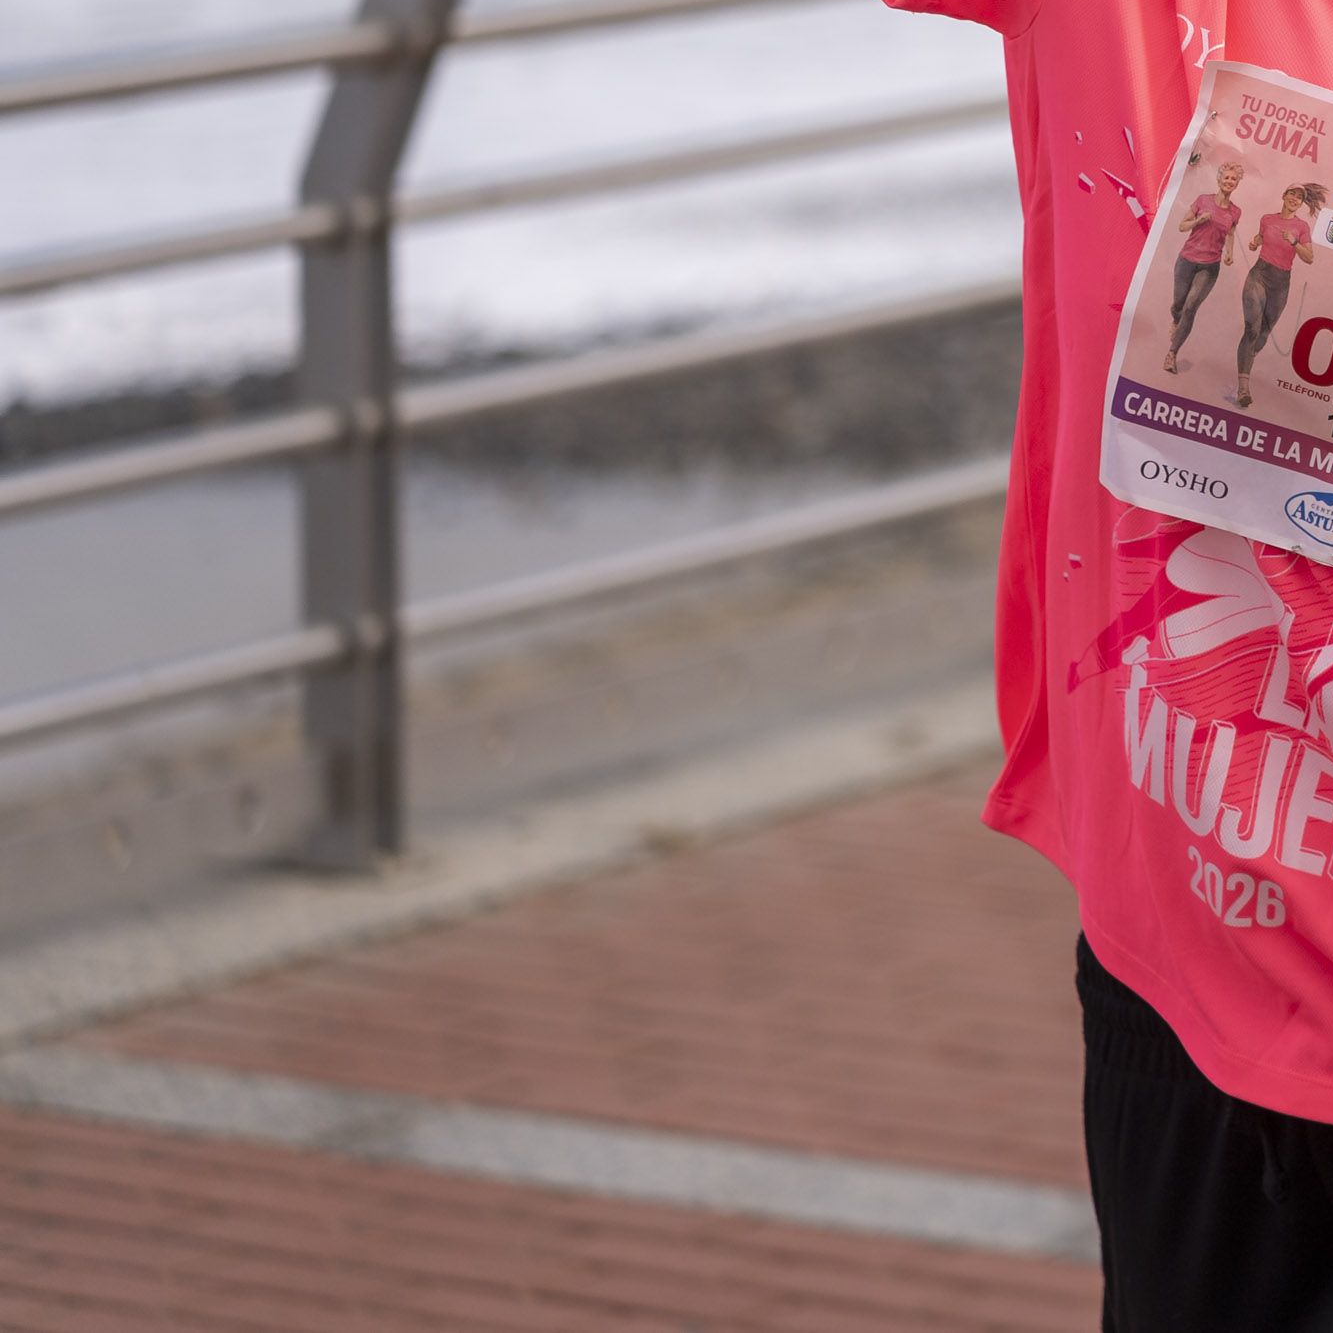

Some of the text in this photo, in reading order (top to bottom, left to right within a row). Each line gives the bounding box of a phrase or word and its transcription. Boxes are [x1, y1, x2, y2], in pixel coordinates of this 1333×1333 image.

[1241, 94, 1327, 136] TU DORSAL
[1235, 113, 1320, 164] SUMA
[1276, 378, 1331, 403] TELÉFONO
[1123, 391, 1229, 442] CARRERA
[1235, 424, 1268, 453] DE
[1272, 436, 1301, 464] LA
[1140, 460, 1229, 500] OYSHO
[1187, 844, 1287, 928] 2026
